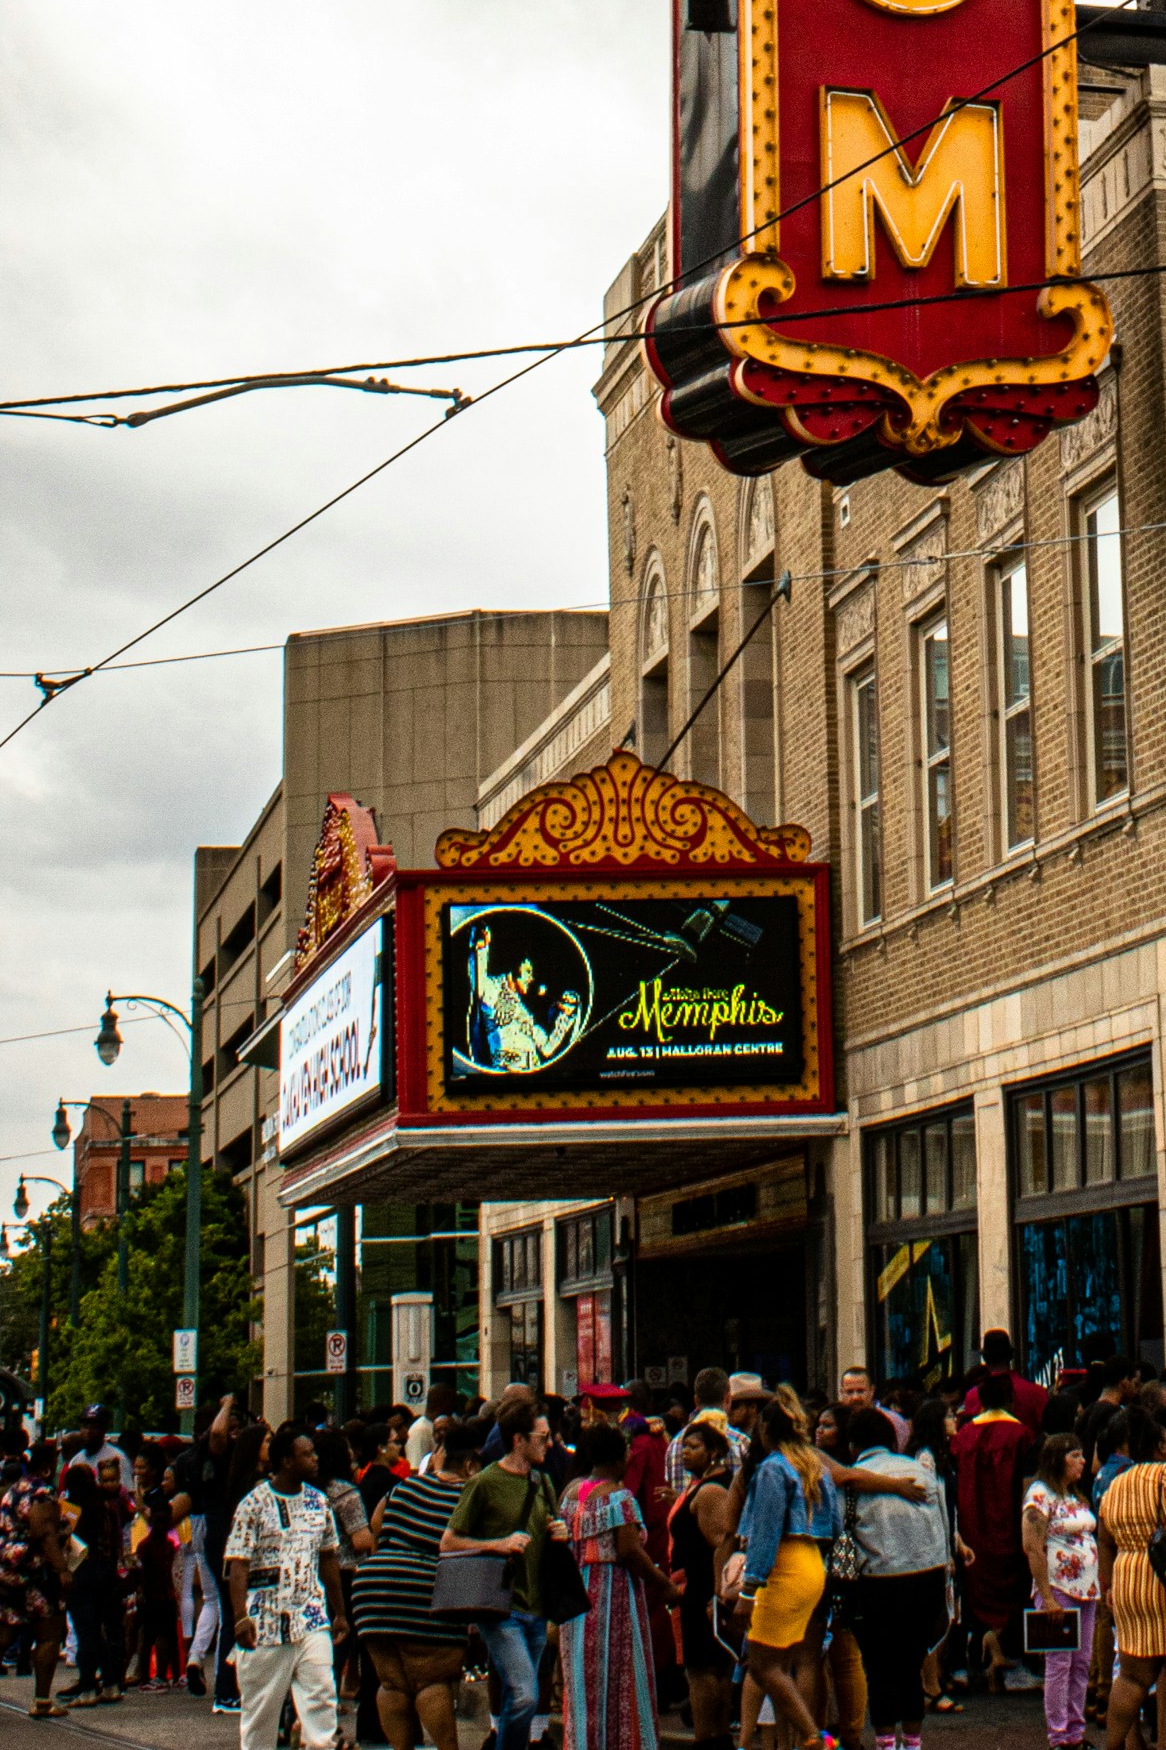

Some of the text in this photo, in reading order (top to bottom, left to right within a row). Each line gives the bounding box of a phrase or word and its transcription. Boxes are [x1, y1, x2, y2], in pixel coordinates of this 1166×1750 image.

[618, 978, 783, 1042] Memphis
[330, 1017, 360, 1096] SCHOOL
[662, 1043, 731, 1057] HALLORAN
[734, 1041, 783, 1055] CENTRE
